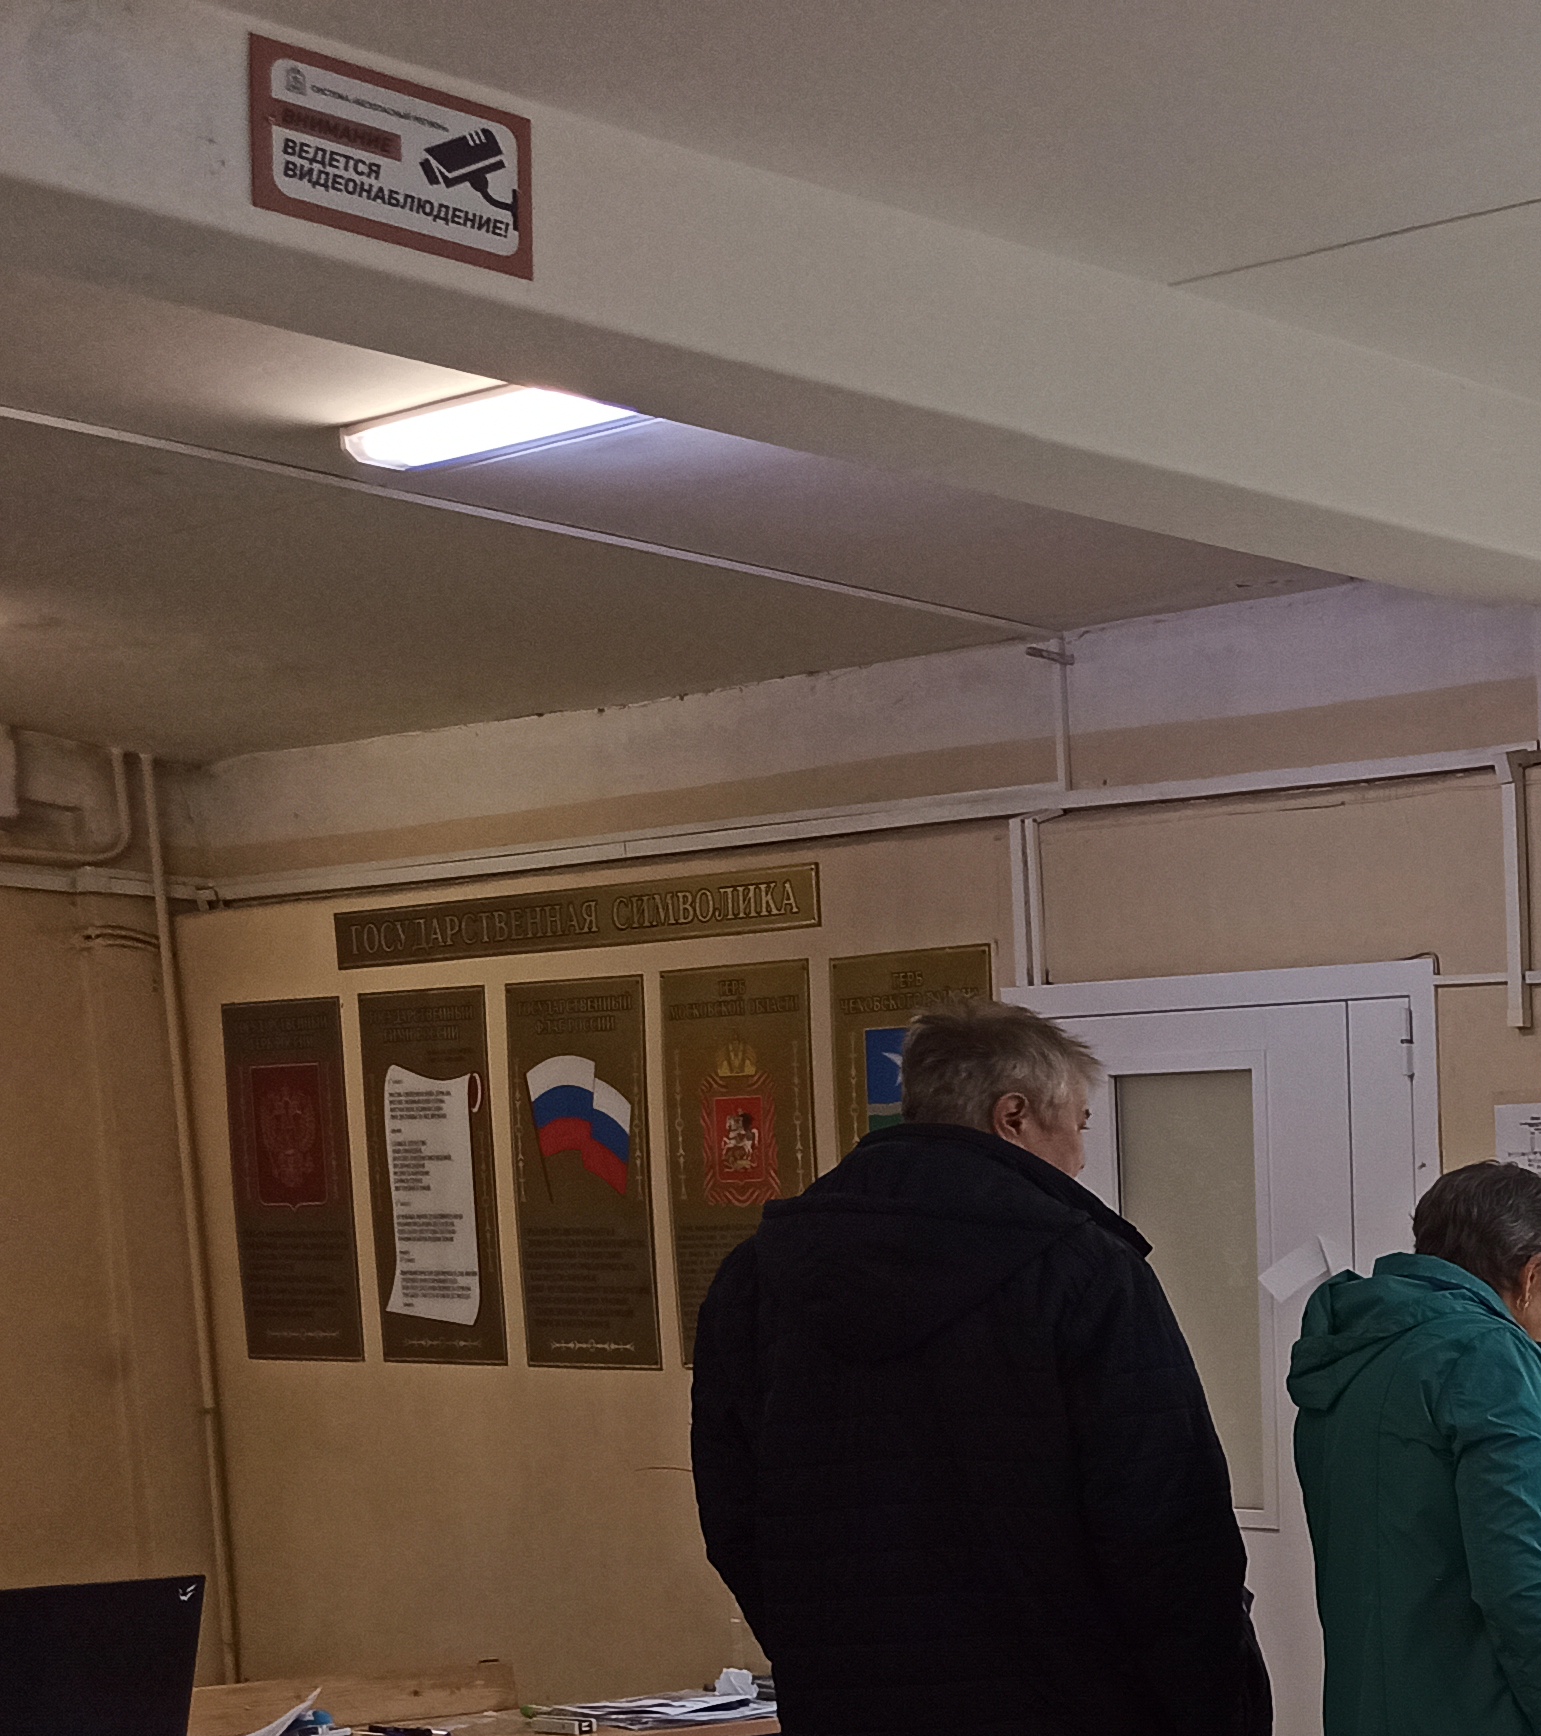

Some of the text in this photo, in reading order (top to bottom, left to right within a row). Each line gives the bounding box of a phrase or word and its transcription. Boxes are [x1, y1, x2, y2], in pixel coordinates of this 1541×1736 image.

[282, 106, 393, 154] ВНИМАНИЕ
[283, 137, 381, 180] ВЕДЕТСЯ
[283, 160, 510, 238] ВИДЕОНАБЛЮДЕНИЕ!
[349, 879, 800, 955] ГОСУДАРСТВЕННАЯ СИМВОЛИКА
[892, 972, 924, 989] ГЕРБ
